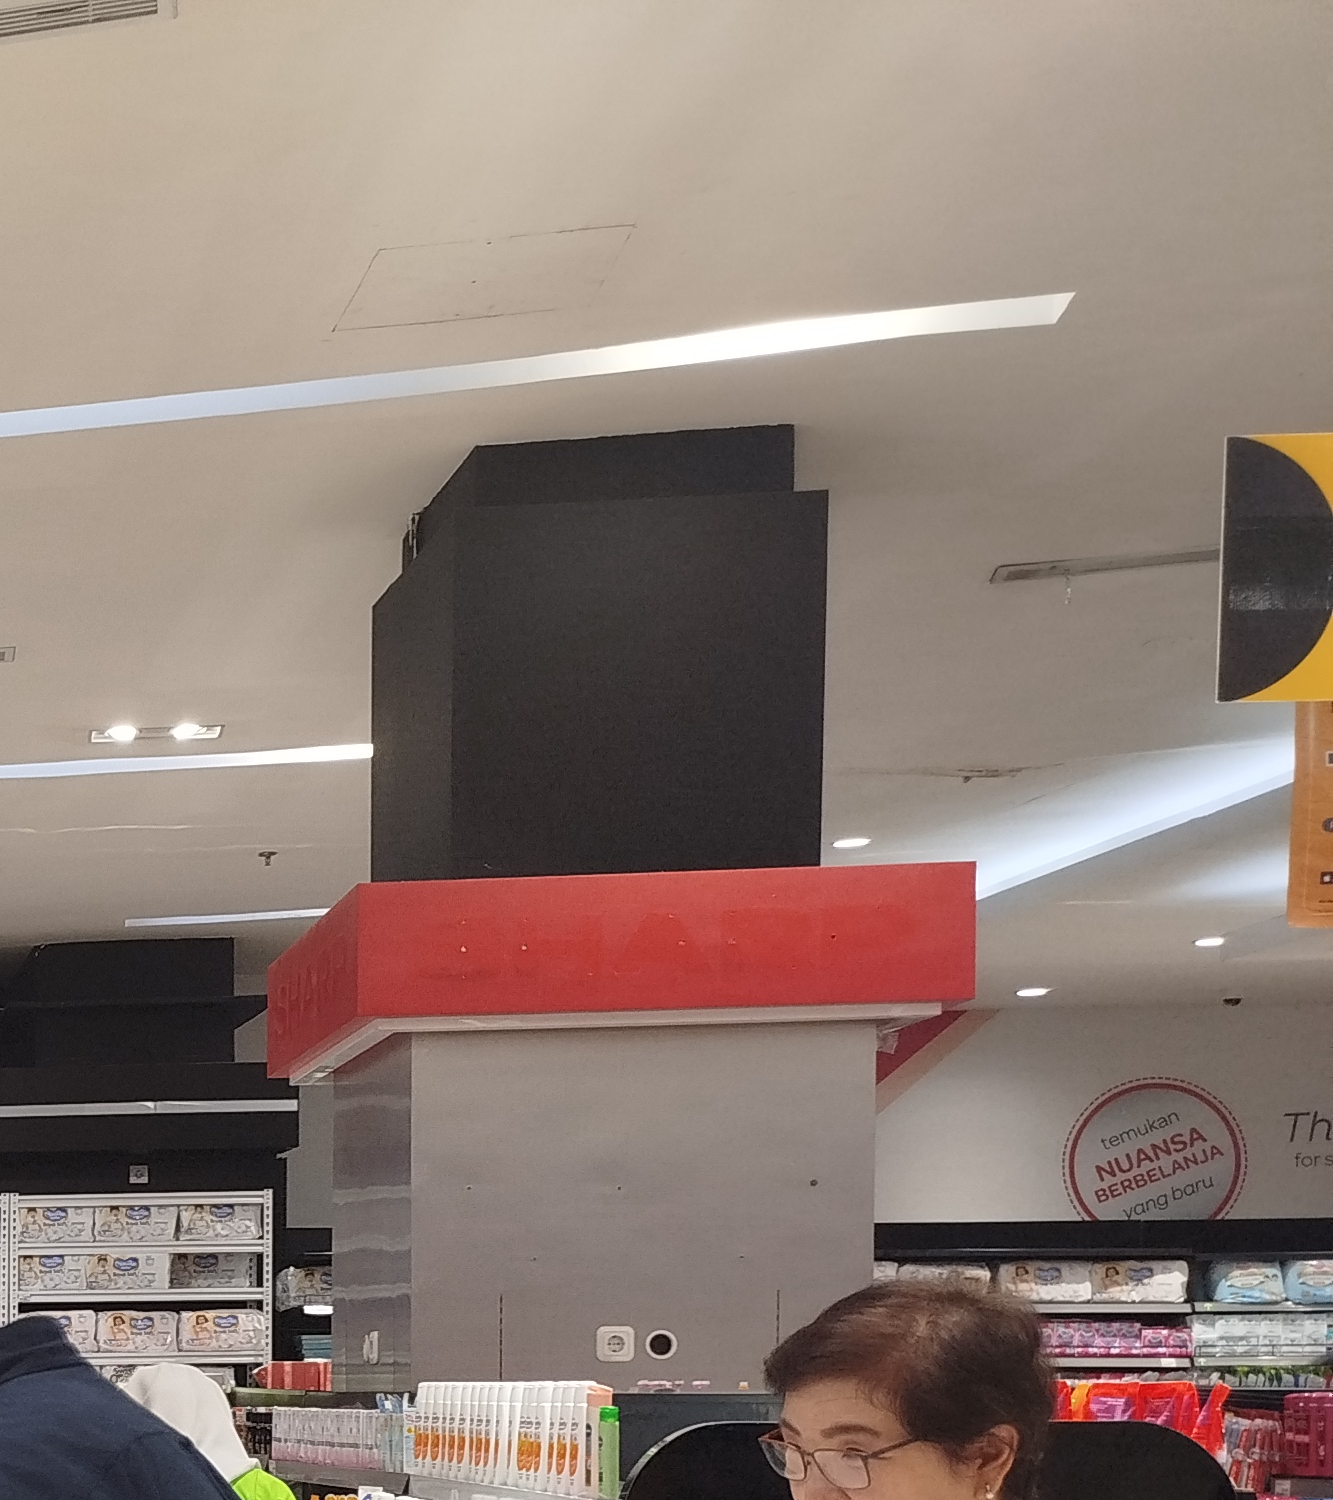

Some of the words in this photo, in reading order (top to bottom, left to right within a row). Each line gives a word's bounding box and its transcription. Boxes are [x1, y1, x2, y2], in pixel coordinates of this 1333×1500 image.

[1100, 1111, 1180, 1150] temukan
[1094, 1145, 1224, 1203] BERBELANJA
[1095, 1127, 1207, 1182] NUANSA
[1295, 1153, 1320, 1167] for
[1122, 1193, 1169, 1220] yang
[1171, 1176, 1214, 1201] baru
